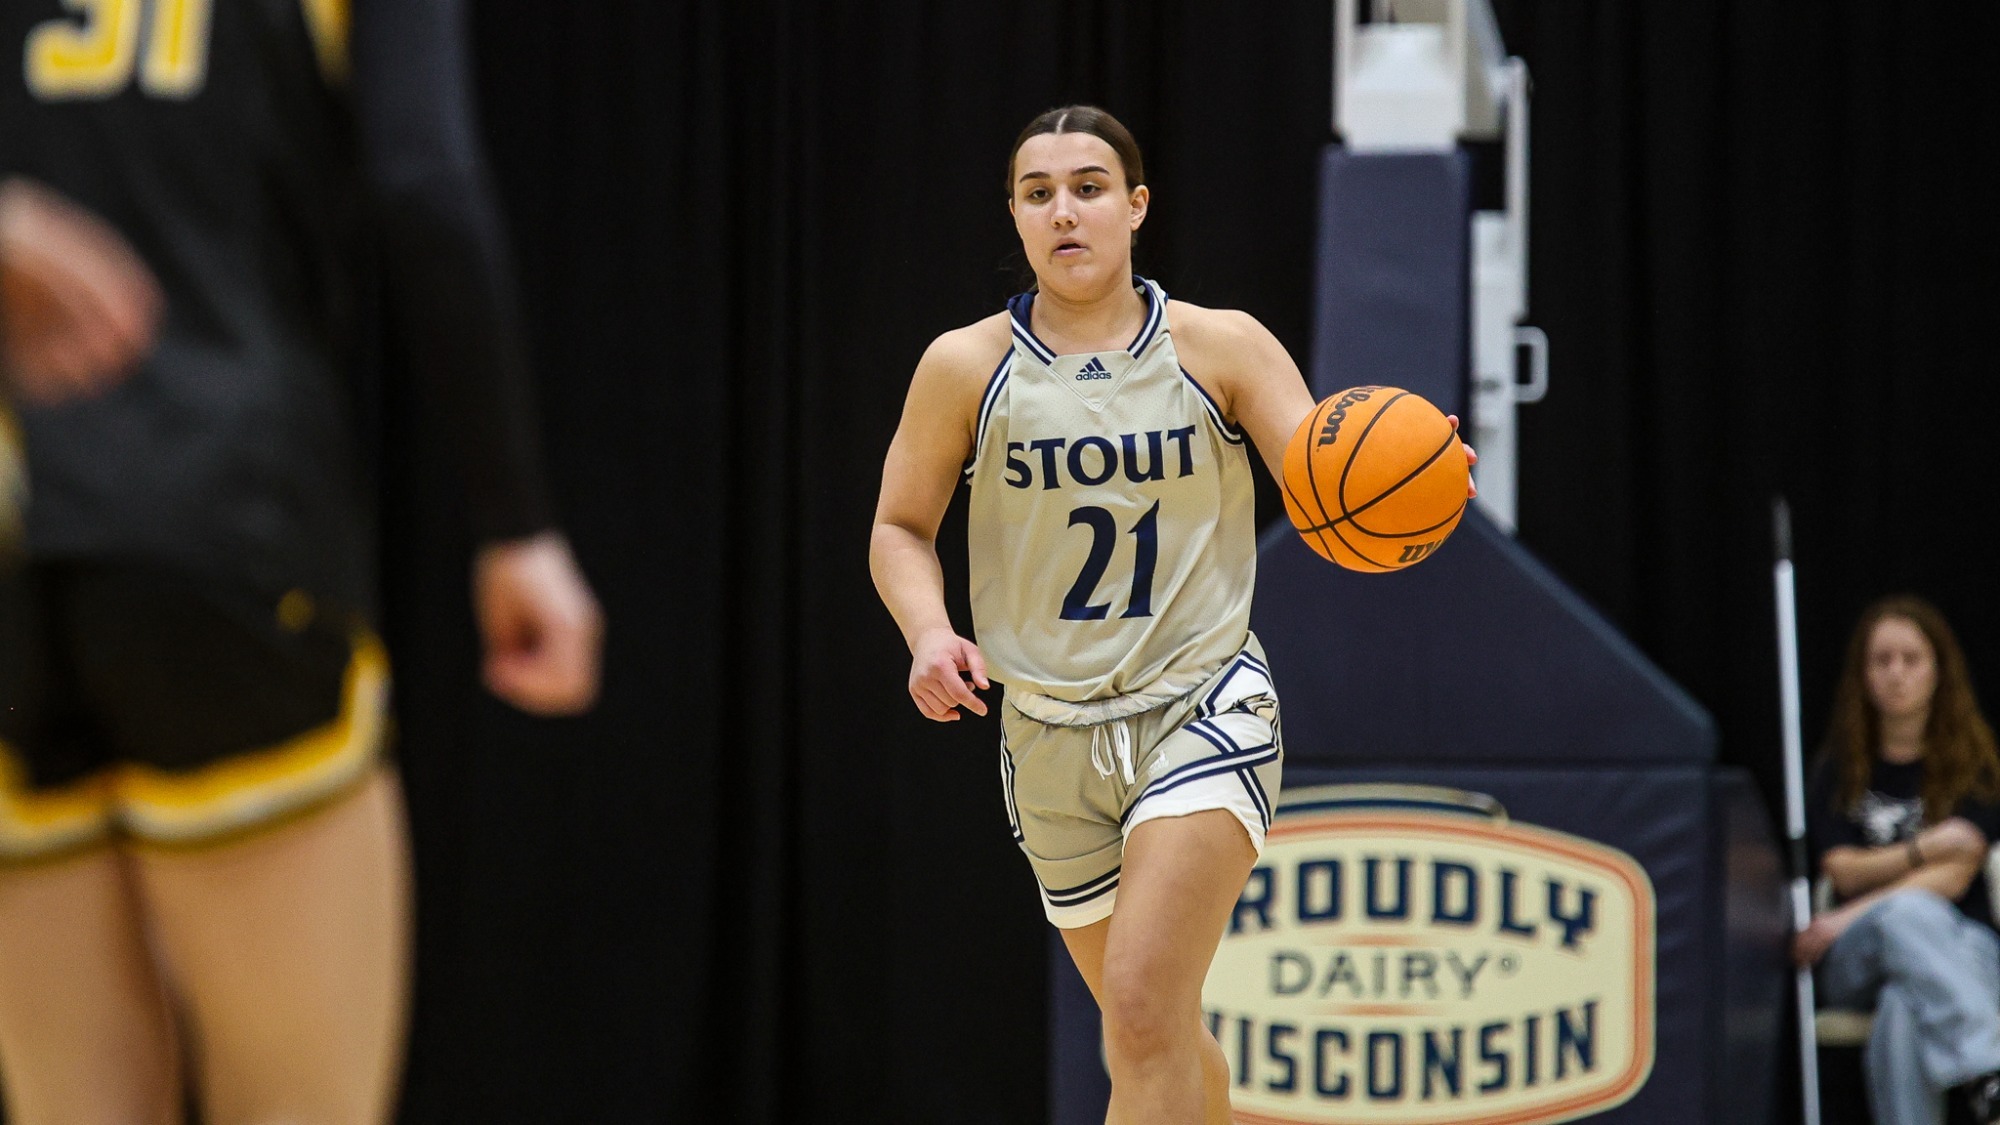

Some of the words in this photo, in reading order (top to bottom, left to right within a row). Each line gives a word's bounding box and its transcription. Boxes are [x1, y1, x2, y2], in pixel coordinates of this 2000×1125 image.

[1075, 371, 1112, 381] adidas
[1004, 424, 1196, 490] STOUT
[1059, 498, 1160, 619] 21
[1230, 854, 1600, 950] ROUDLY
